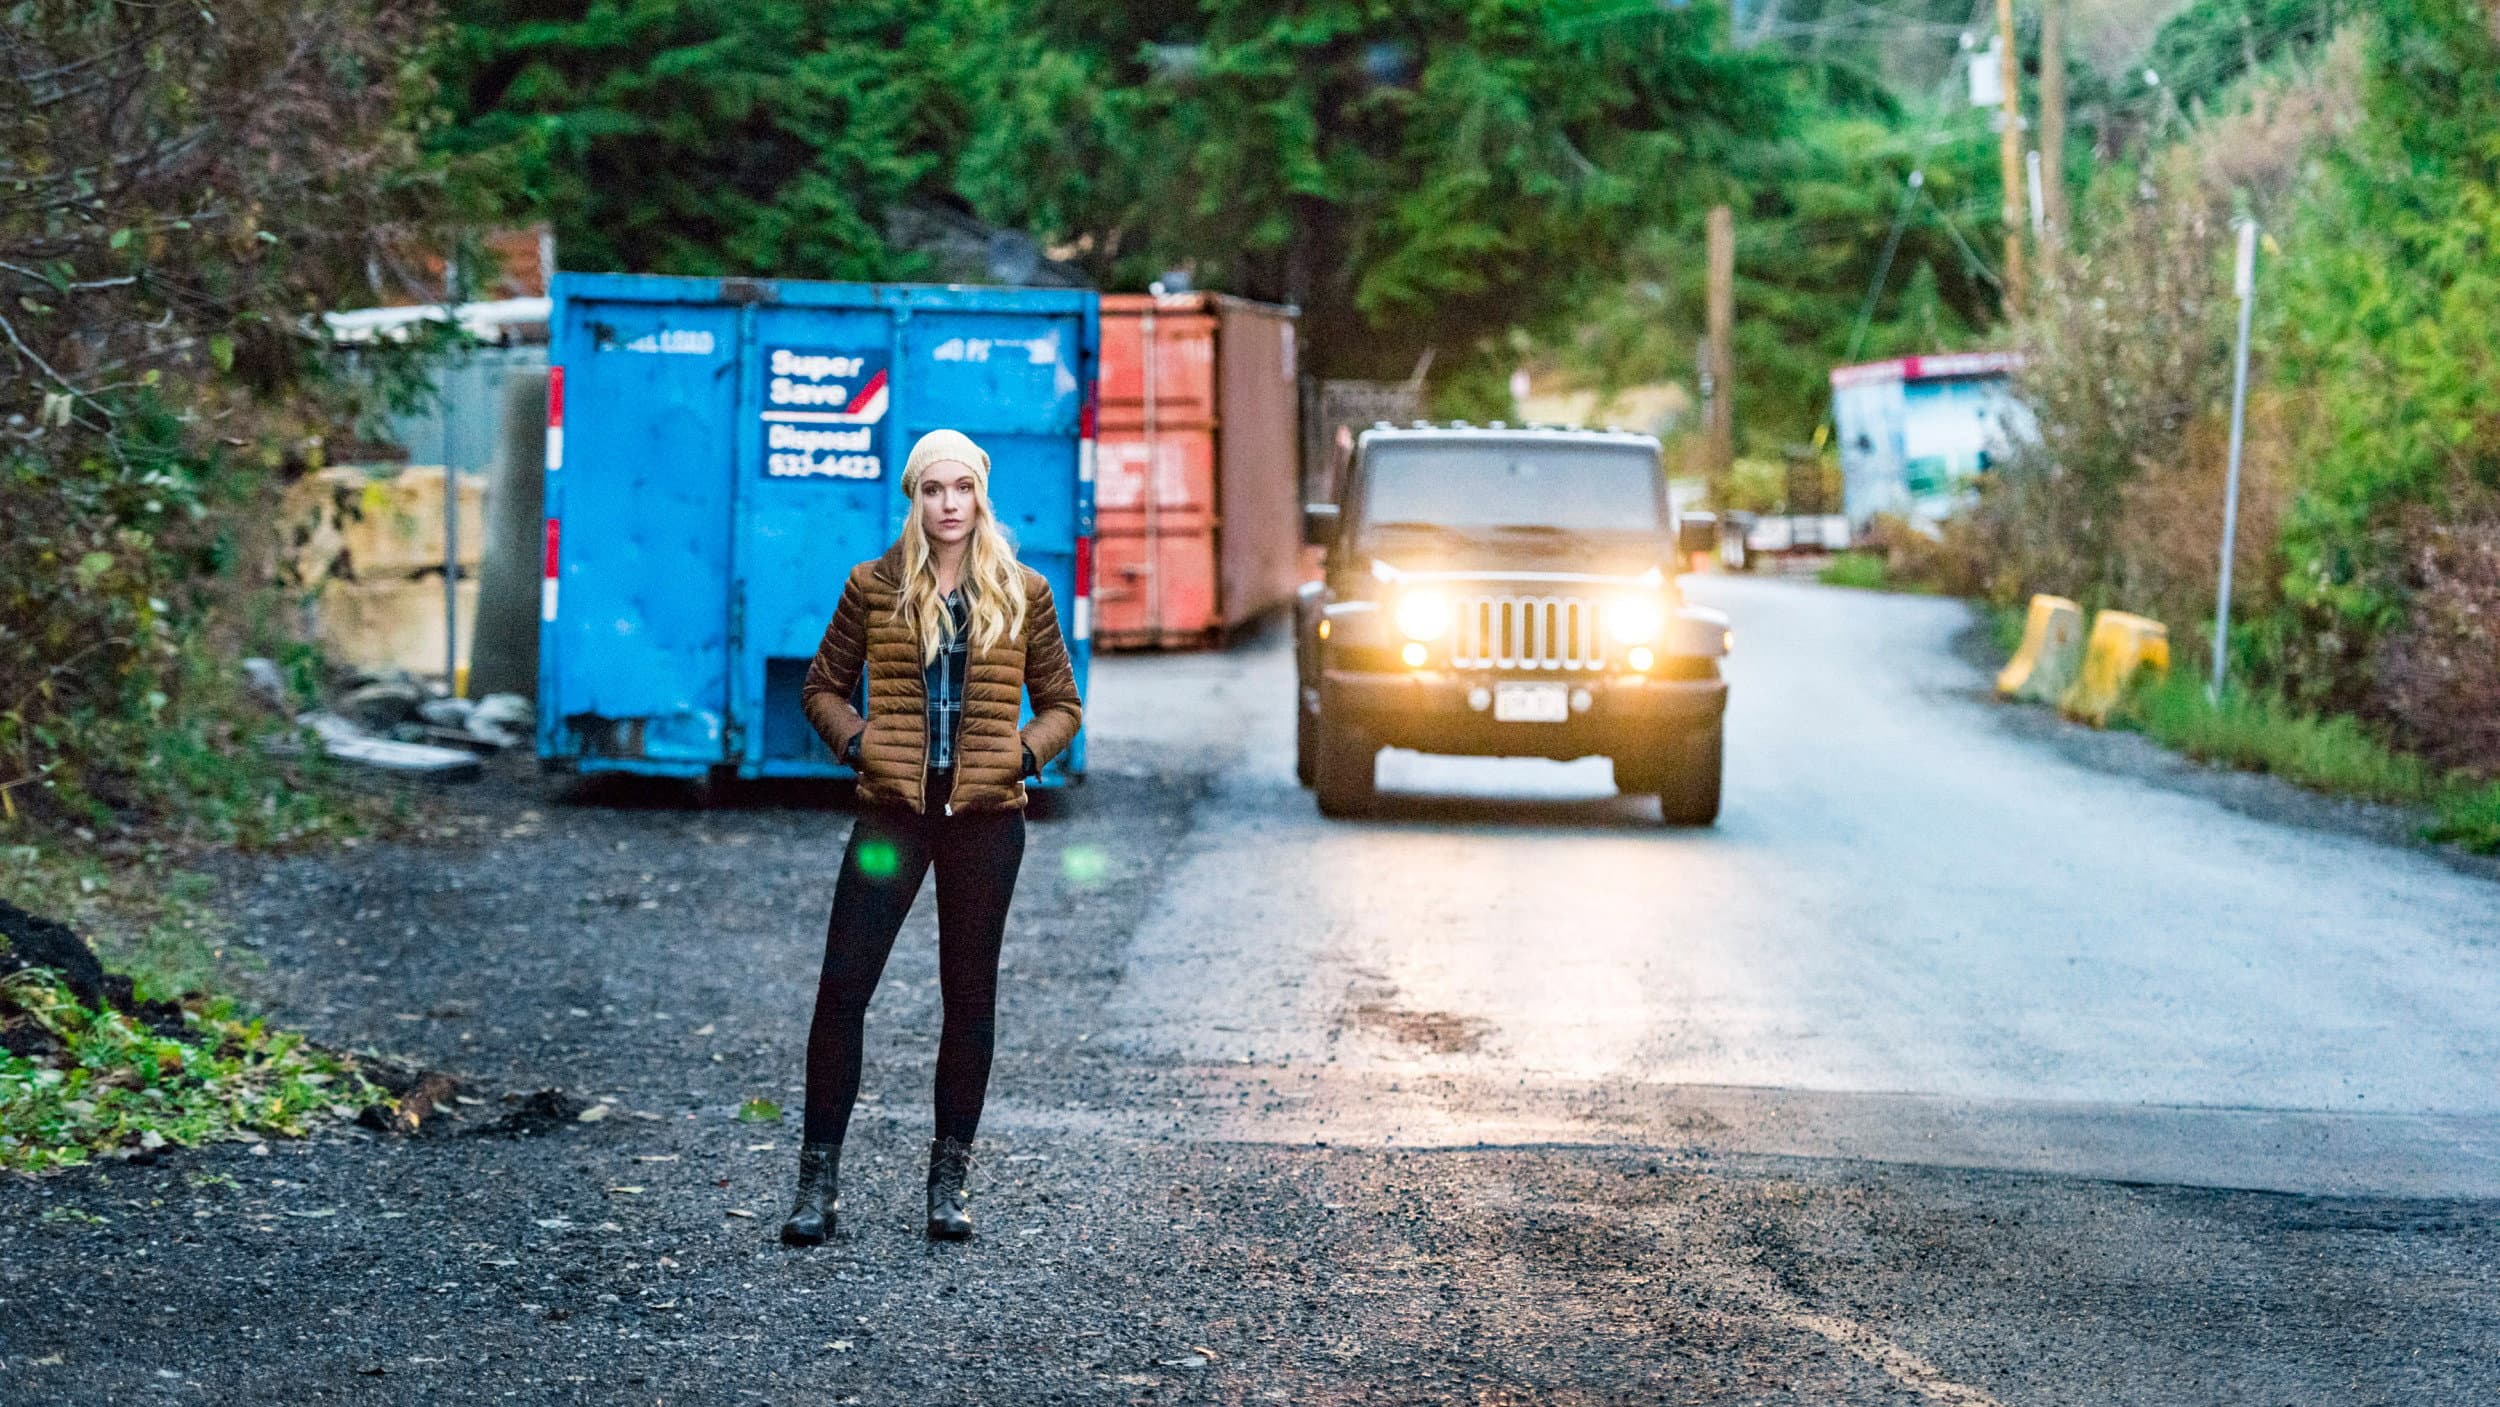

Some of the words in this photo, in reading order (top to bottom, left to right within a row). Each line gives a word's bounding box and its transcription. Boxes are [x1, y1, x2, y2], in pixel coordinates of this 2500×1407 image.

[771, 350, 864, 382] Super
[770, 377, 847, 406] Save
[769, 424, 871, 453] Disposal
